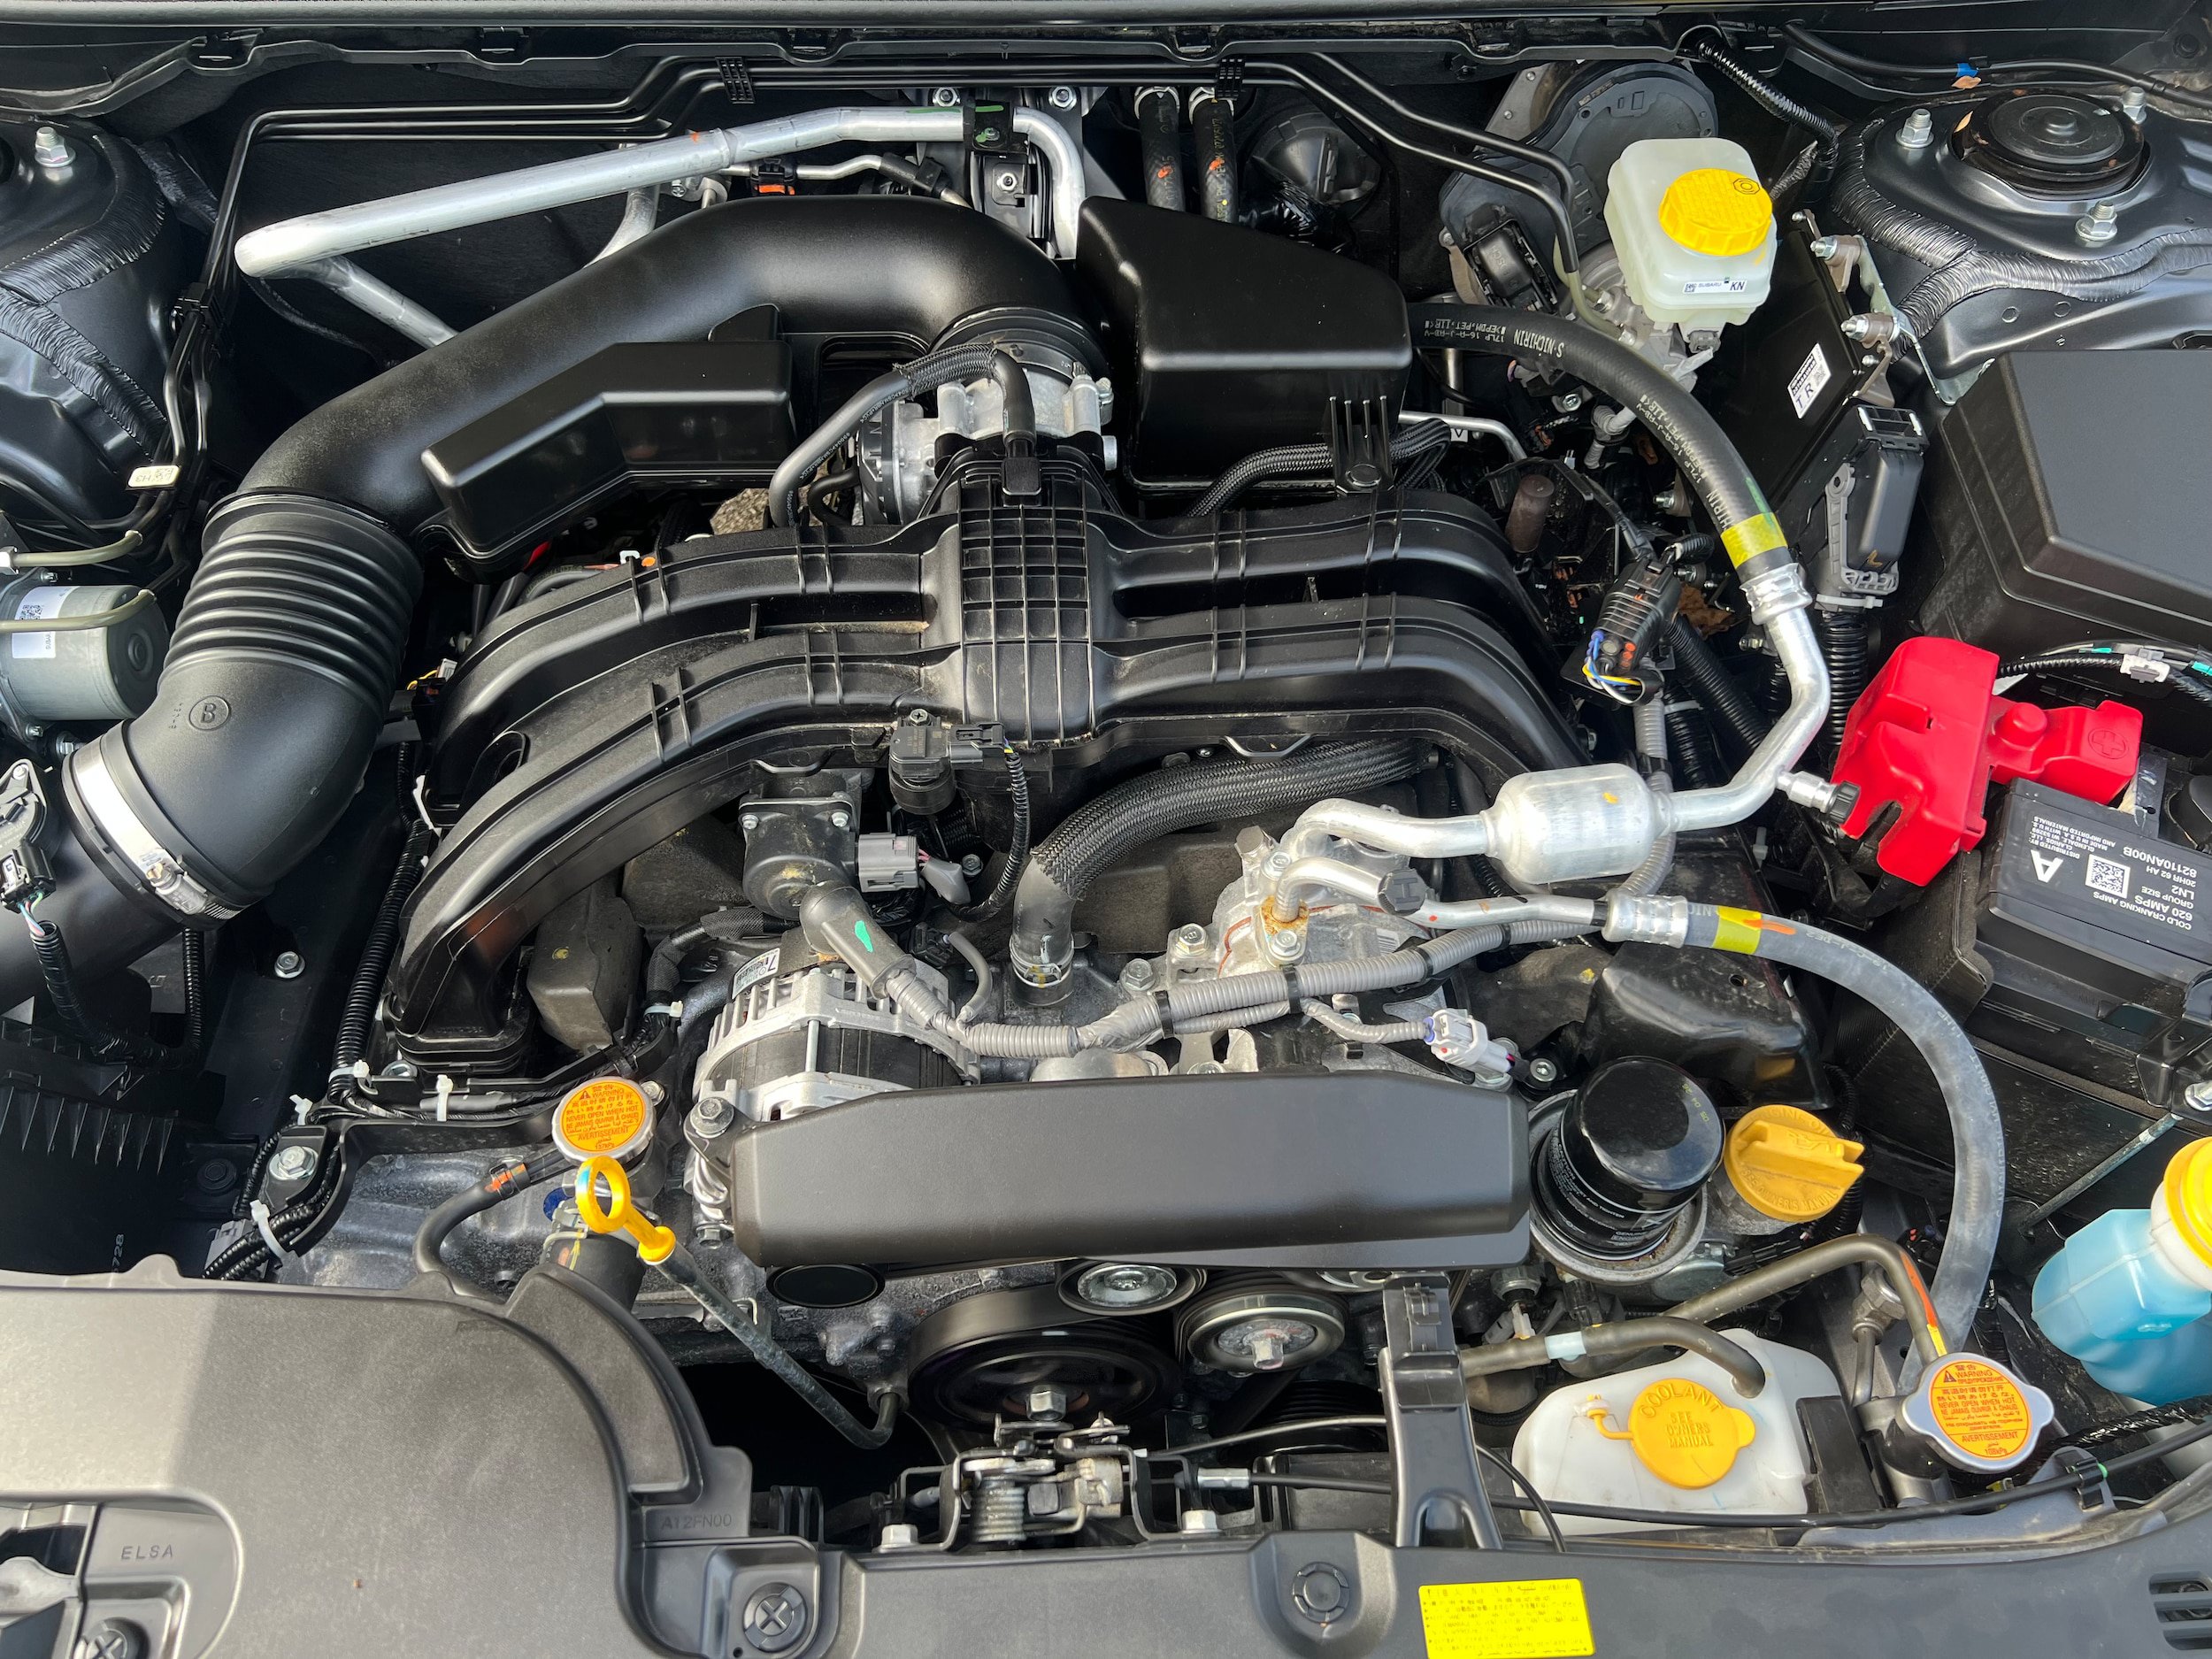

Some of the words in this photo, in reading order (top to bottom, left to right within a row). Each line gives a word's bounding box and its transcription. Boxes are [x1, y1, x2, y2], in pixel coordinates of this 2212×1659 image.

[1730, 281, 1746, 291] KN
[201, 703, 216, 723] B
[2034, 816, 2070, 832] MATERIALS
[2045, 826, 2062, 835] WITH
[2029, 837, 2039, 846] BY:
[2070, 828, 2101, 842] IMPORTED
[2039, 842, 2080, 859] DISTRIBUTED
[2089, 841, 2108, 851] MADE
[2102, 839, 2116, 848] AND
[2031, 849, 2063, 883] A
[2123, 846, 2197, 879] 82110AN00B
[2147, 865, 2160, 875] AH
[2161, 871, 2171, 879] 62
[2173, 875, 2197, 887] 20HR
[2093, 891, 2118, 904] AMPS
[2141, 886, 2161, 898] SIZE
[2171, 885, 2194, 901] LN2
[2134, 895, 2170, 913] AMPS
[2162, 895, 2194, 910] GROUP
[2119, 901, 2166, 922] CRANKING
[2171, 907, 2193, 921] 620
[2167, 916, 2192, 931] COLD
[593, 1088, 625, 1097] WARNING
[578, 1125, 629, 1141] AVERTISSEMENT
[1741, 1168, 1758, 1188] SEE
[1758, 1185, 1800, 1211] OWNER'S
[1801, 1189, 1839, 1212] MANUAL
[1639, 1383, 1724, 1418] COOLANT
[1671, 1411, 1692, 1424] SEE
[1668, 1434, 1714, 1448] MANUAL
[1962, 1432, 2019, 1442] AVERTISSEMENT
[121, 1544, 173, 1560] ELSA
